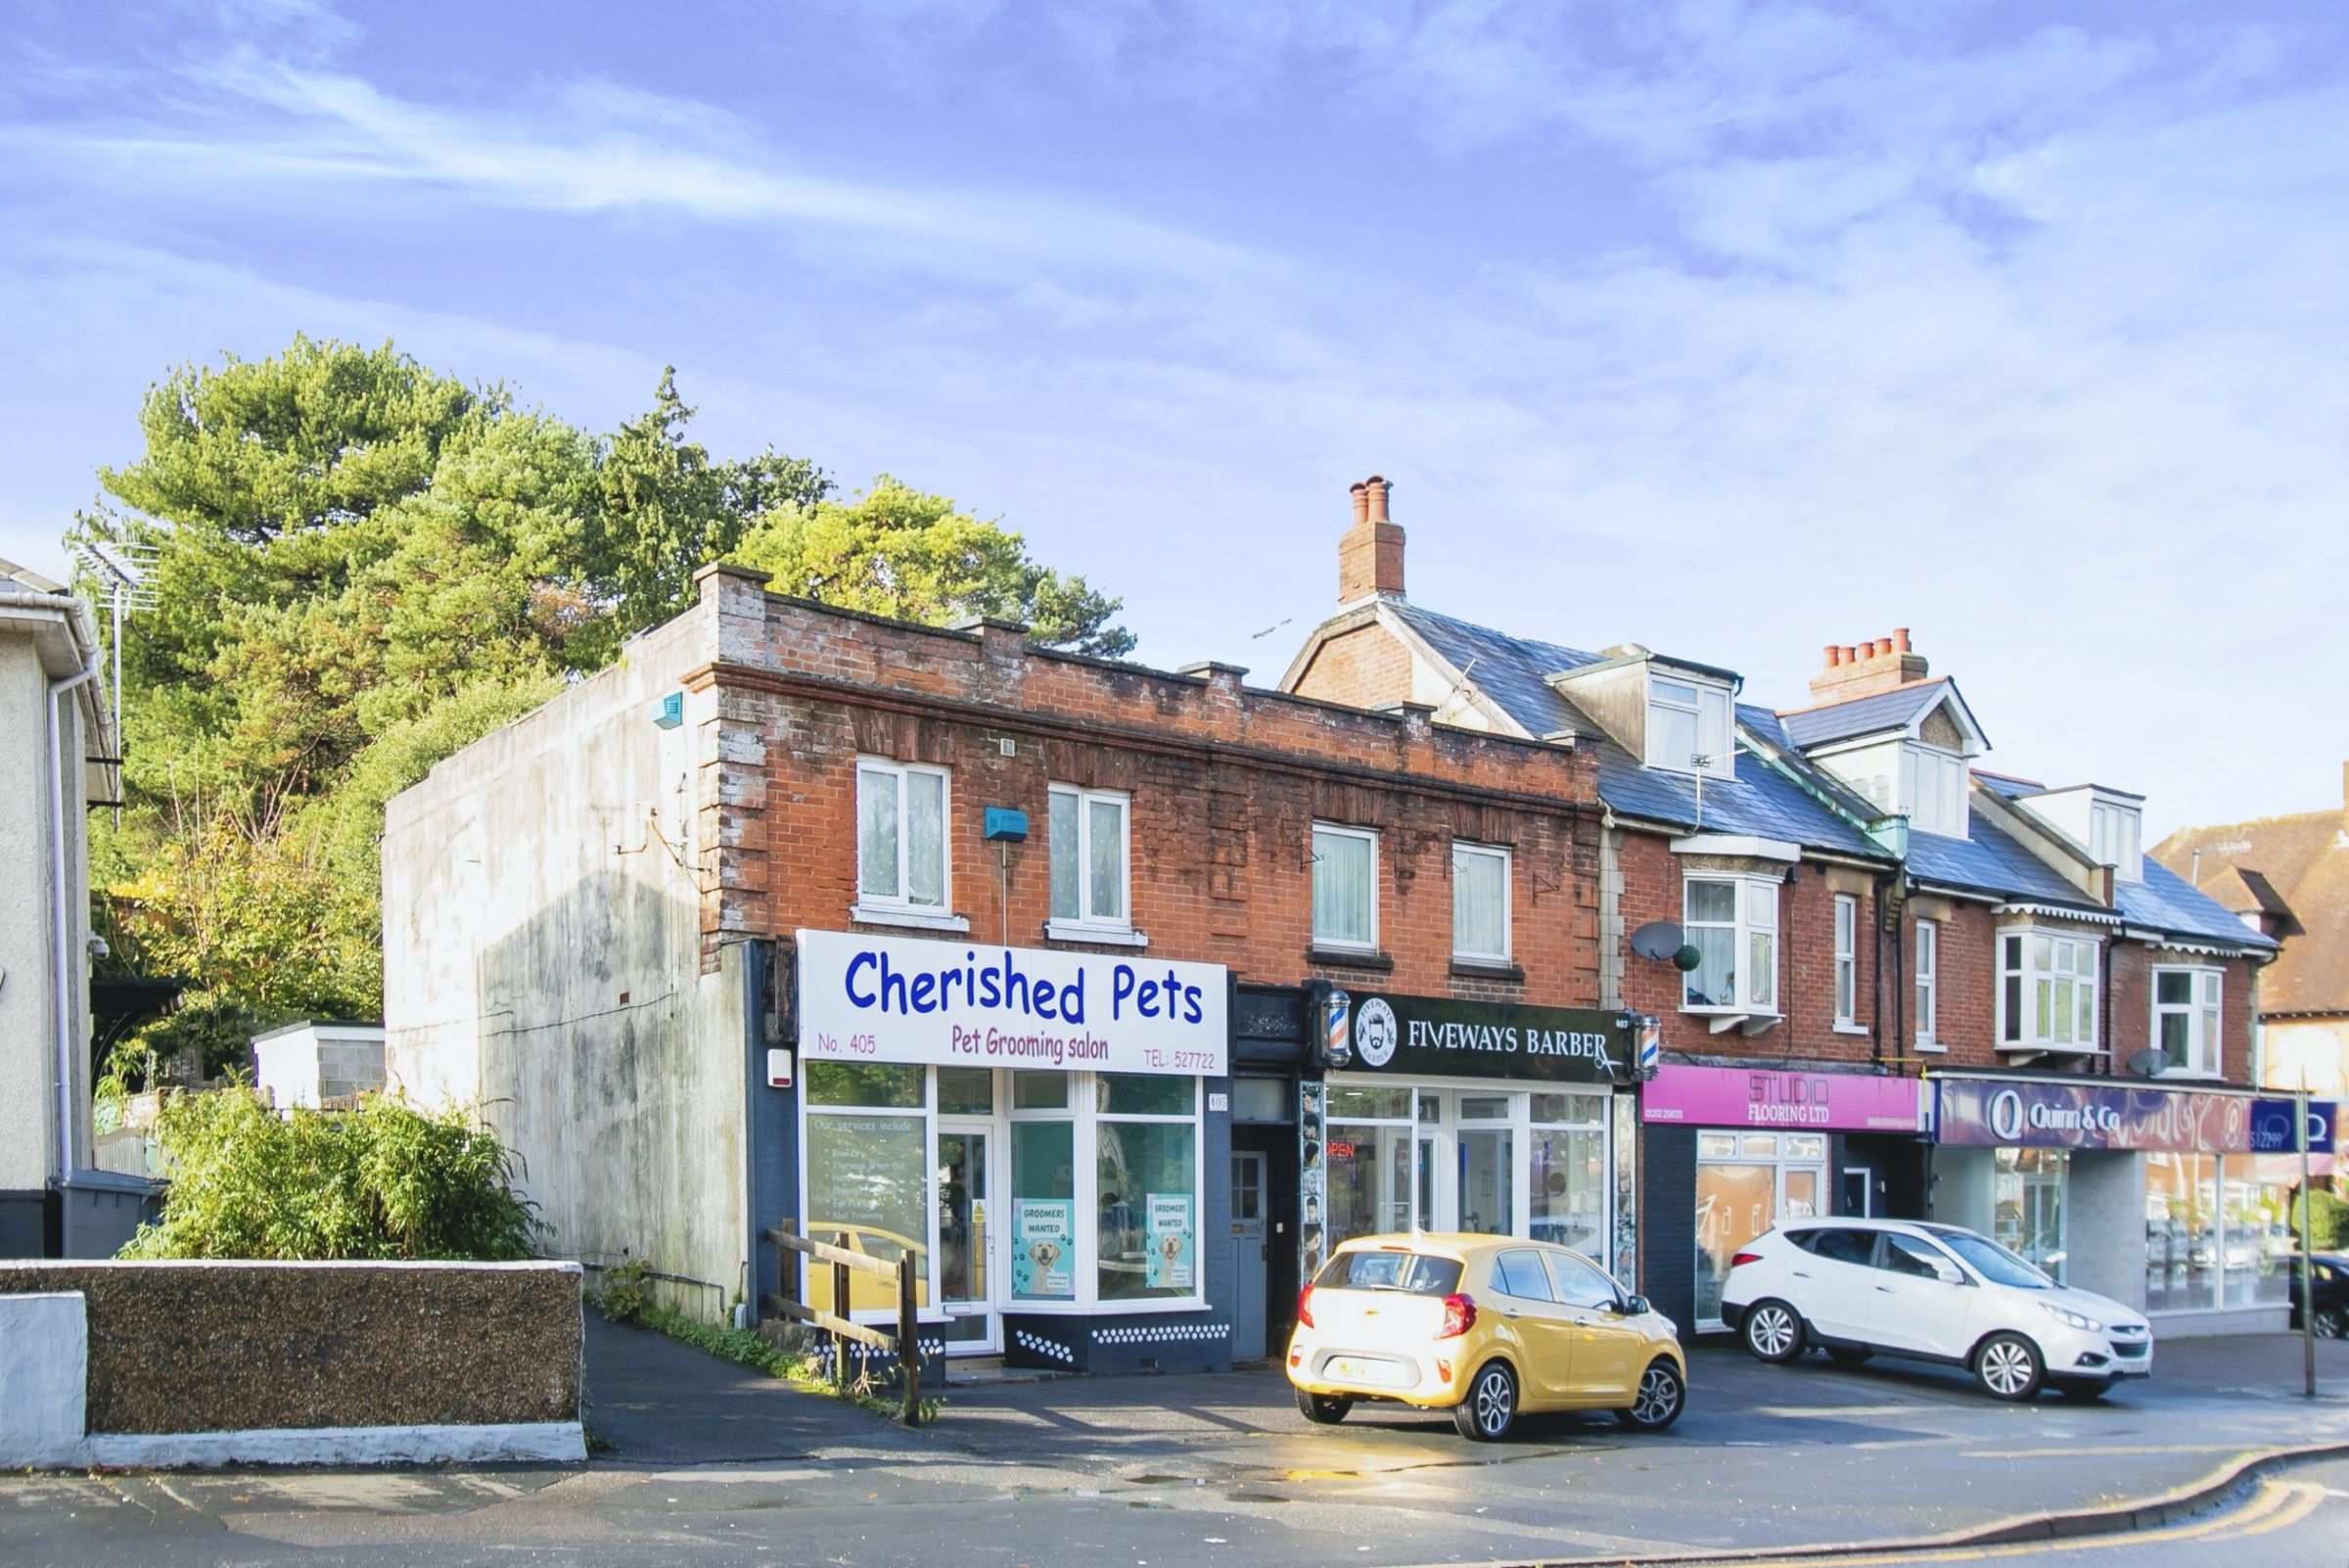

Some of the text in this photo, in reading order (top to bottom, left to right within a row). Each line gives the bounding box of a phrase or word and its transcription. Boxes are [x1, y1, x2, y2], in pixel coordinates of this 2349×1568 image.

[845, 950, 1203, 1025] Cherished Pets
[817, 1032, 876, 1054] No. 405
[951, 1025, 1109, 1065] Pet Grooming salon
[1407, 1020, 1612, 1062] FIVEWAYS BARBER
[1143, 1048, 1215, 1070] TEL: 527722
[1748, 1075, 1830, 1105] STUDIO
[1210, 1095, 1227, 1110] 405
[814, 1119, 833, 1130] Our
[837, 1122, 877, 1130] services
[1748, 1104, 1829, 1124] FLOORING LTD
[1990, 1089, 2121, 1141] Q Quinn & Co
[1024, 1208, 1065, 1219] GROOMERS
[1154, 1203, 1187, 1214] GROOMERS
[1028, 1223, 1061, 1234] WANTED
[1158, 1219, 1183, 1228] WANTED
